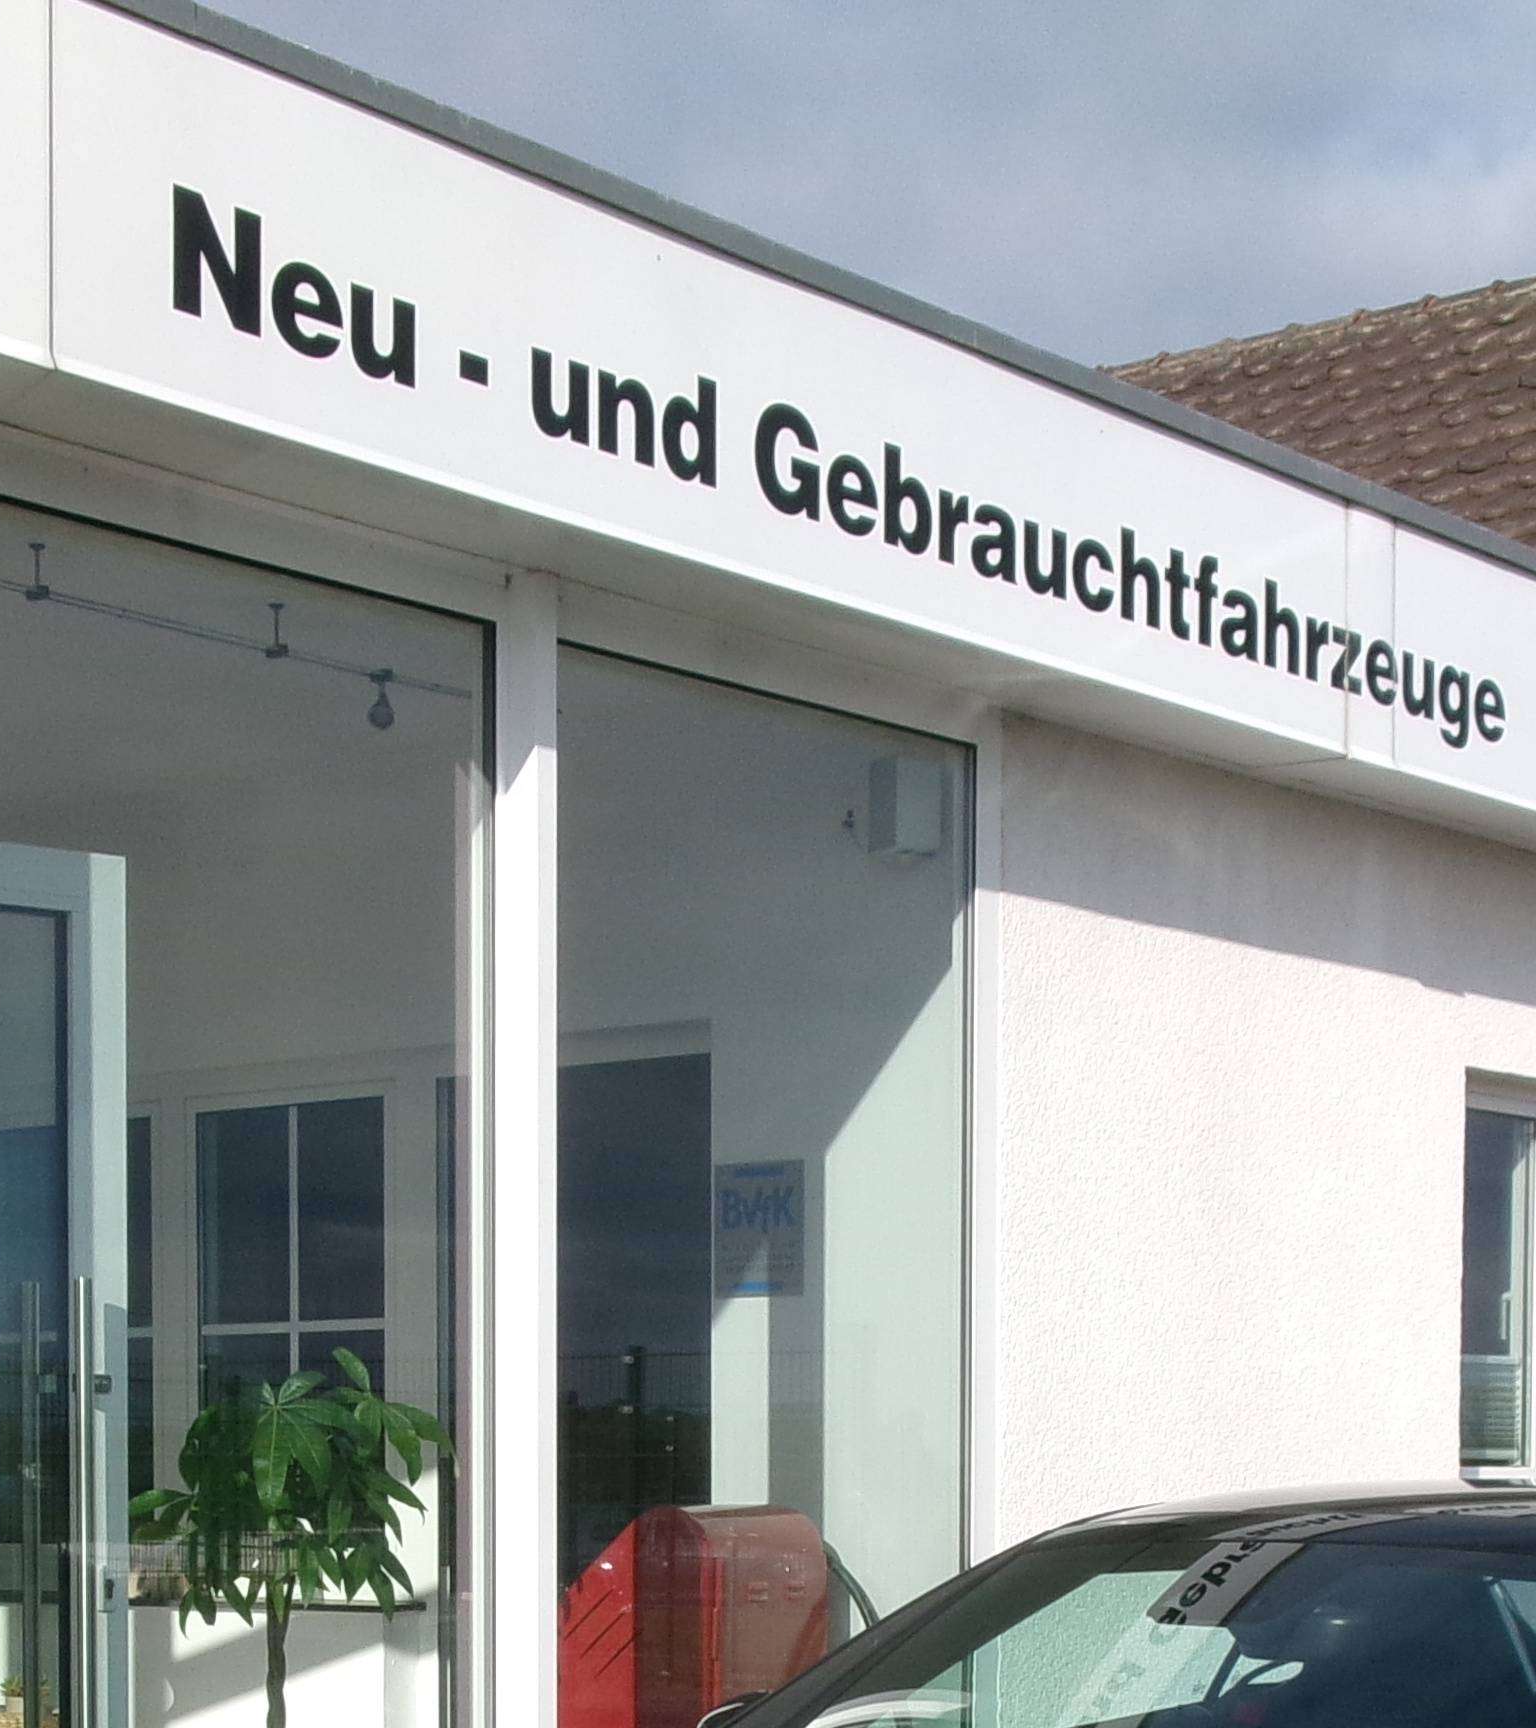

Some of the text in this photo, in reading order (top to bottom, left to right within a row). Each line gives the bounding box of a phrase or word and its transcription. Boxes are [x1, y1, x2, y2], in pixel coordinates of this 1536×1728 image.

[170, 182, 1508, 750] Neu - und Gebrauchtfahrzeuge
